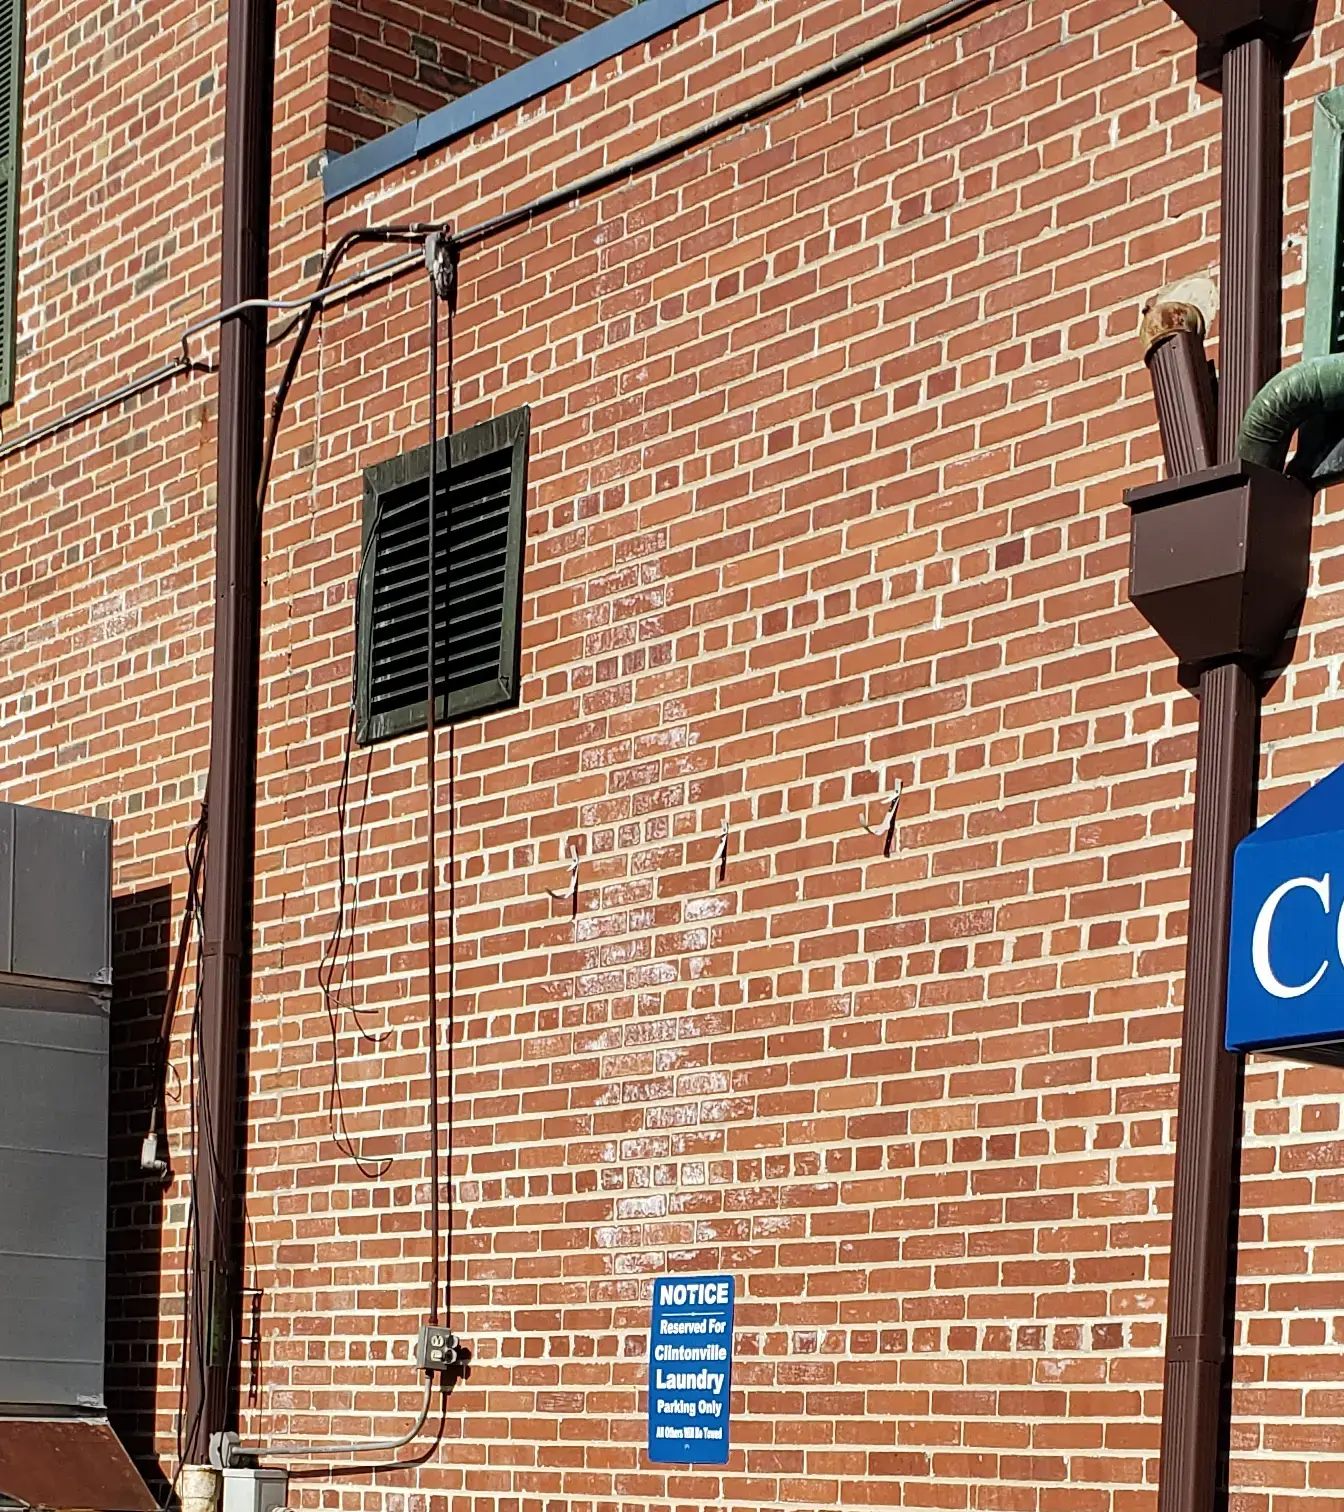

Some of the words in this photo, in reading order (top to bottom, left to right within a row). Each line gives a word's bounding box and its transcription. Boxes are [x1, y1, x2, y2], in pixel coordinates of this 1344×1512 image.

[660, 1283, 729, 1305] NOTICE
[660, 1319, 707, 1335] Reserved
[709, 1318, 726, 1334] For
[655, 1345, 727, 1361] Clintonville
[656, 1368, 725, 1394] Laundry
[657, 1399, 696, 1417] Parking
[698, 1400, 723, 1418] Only
